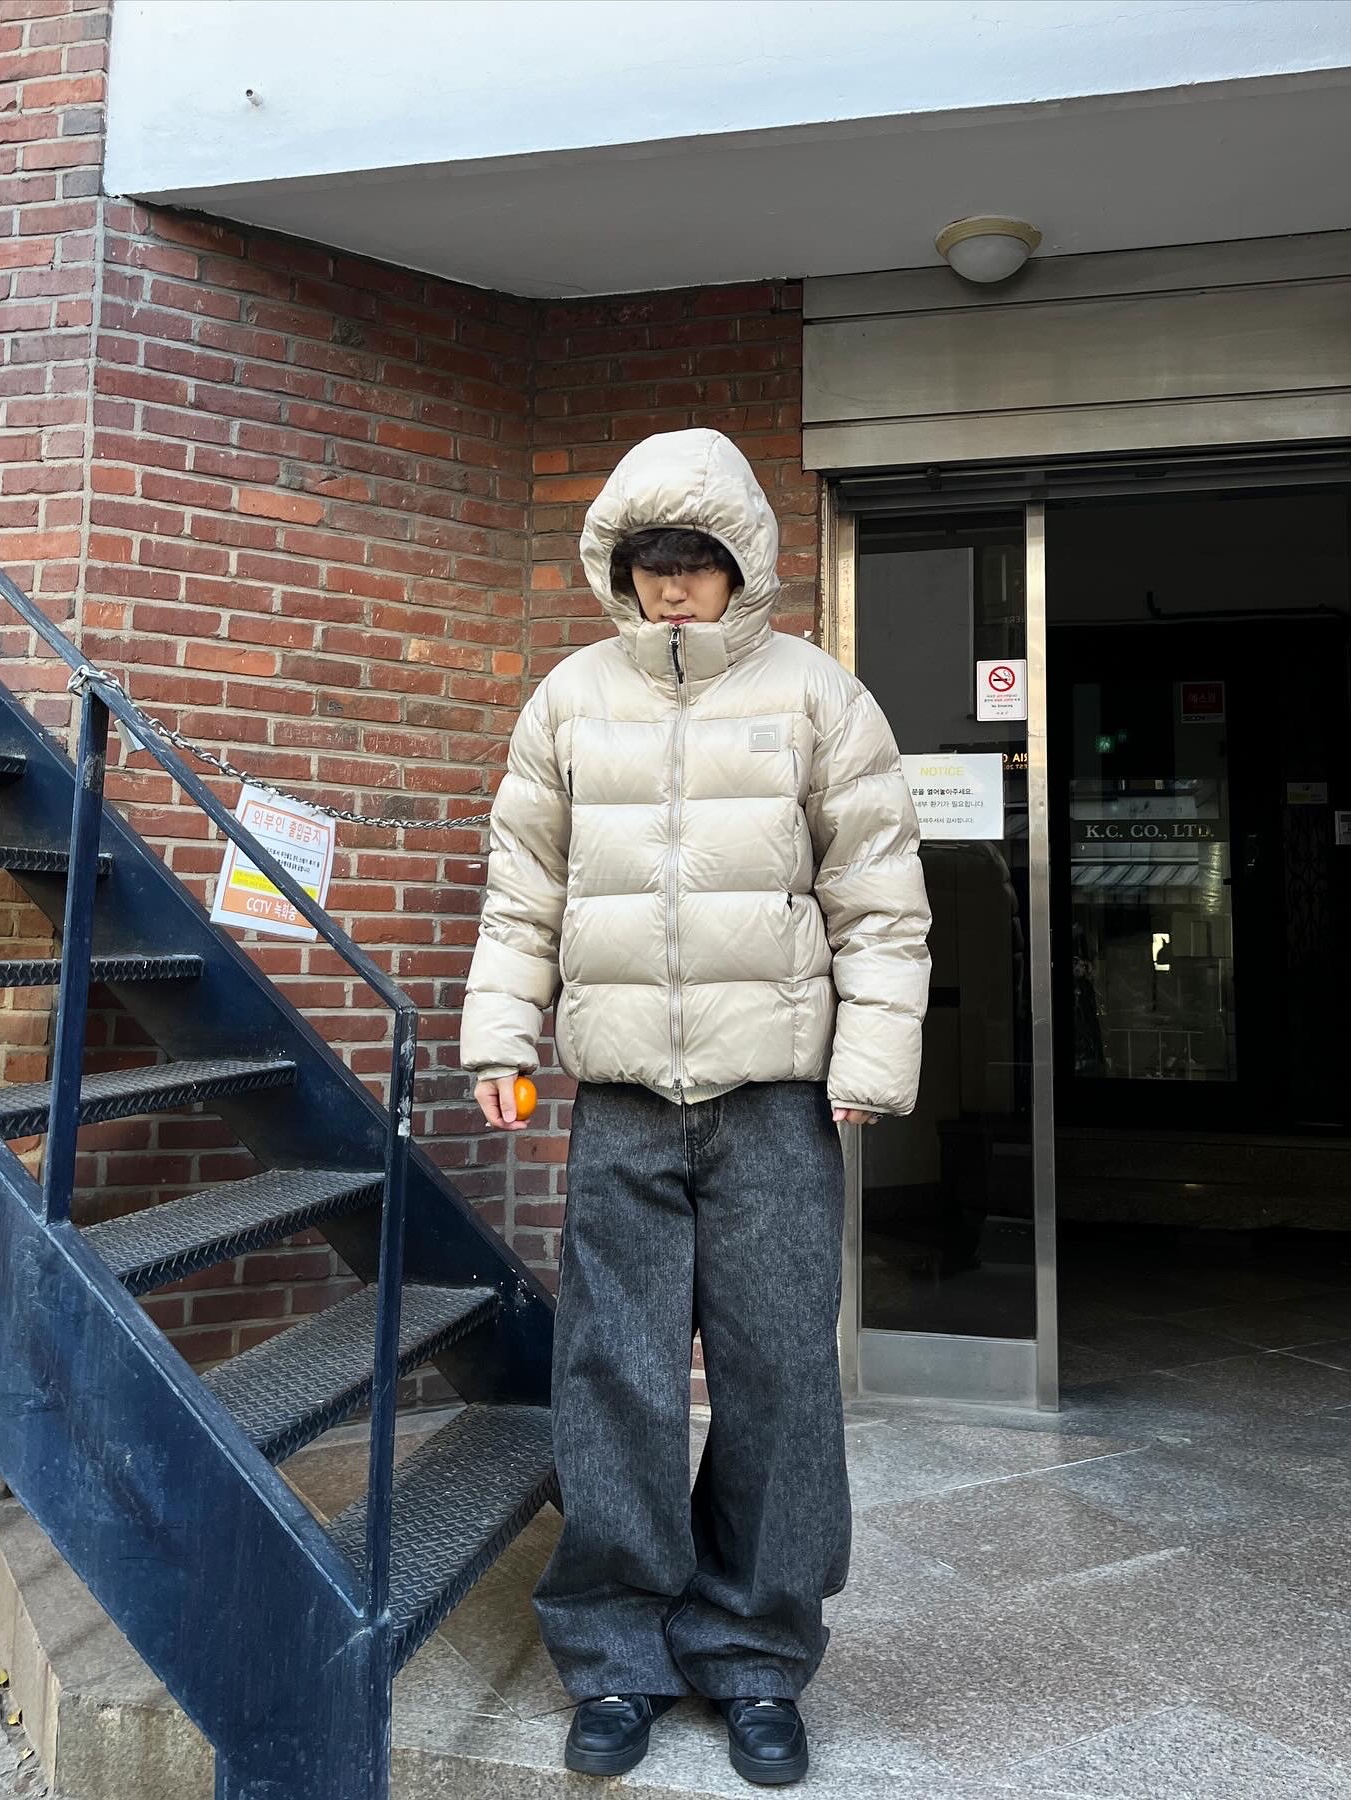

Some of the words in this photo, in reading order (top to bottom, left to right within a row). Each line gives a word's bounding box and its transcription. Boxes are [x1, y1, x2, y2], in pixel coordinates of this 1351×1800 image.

[920, 767, 964, 777] NOTICE
[252, 809, 286, 833] 외부인
[289, 820, 321, 844] 출입금지
[1085, 824, 1123, 838] K.C.
[1130, 824, 1168, 840] CO.,
[1172, 824, 1215, 838] LTD.
[247, 897, 273, 914] CCTV
[274, 900, 298, 921] 녹화중
